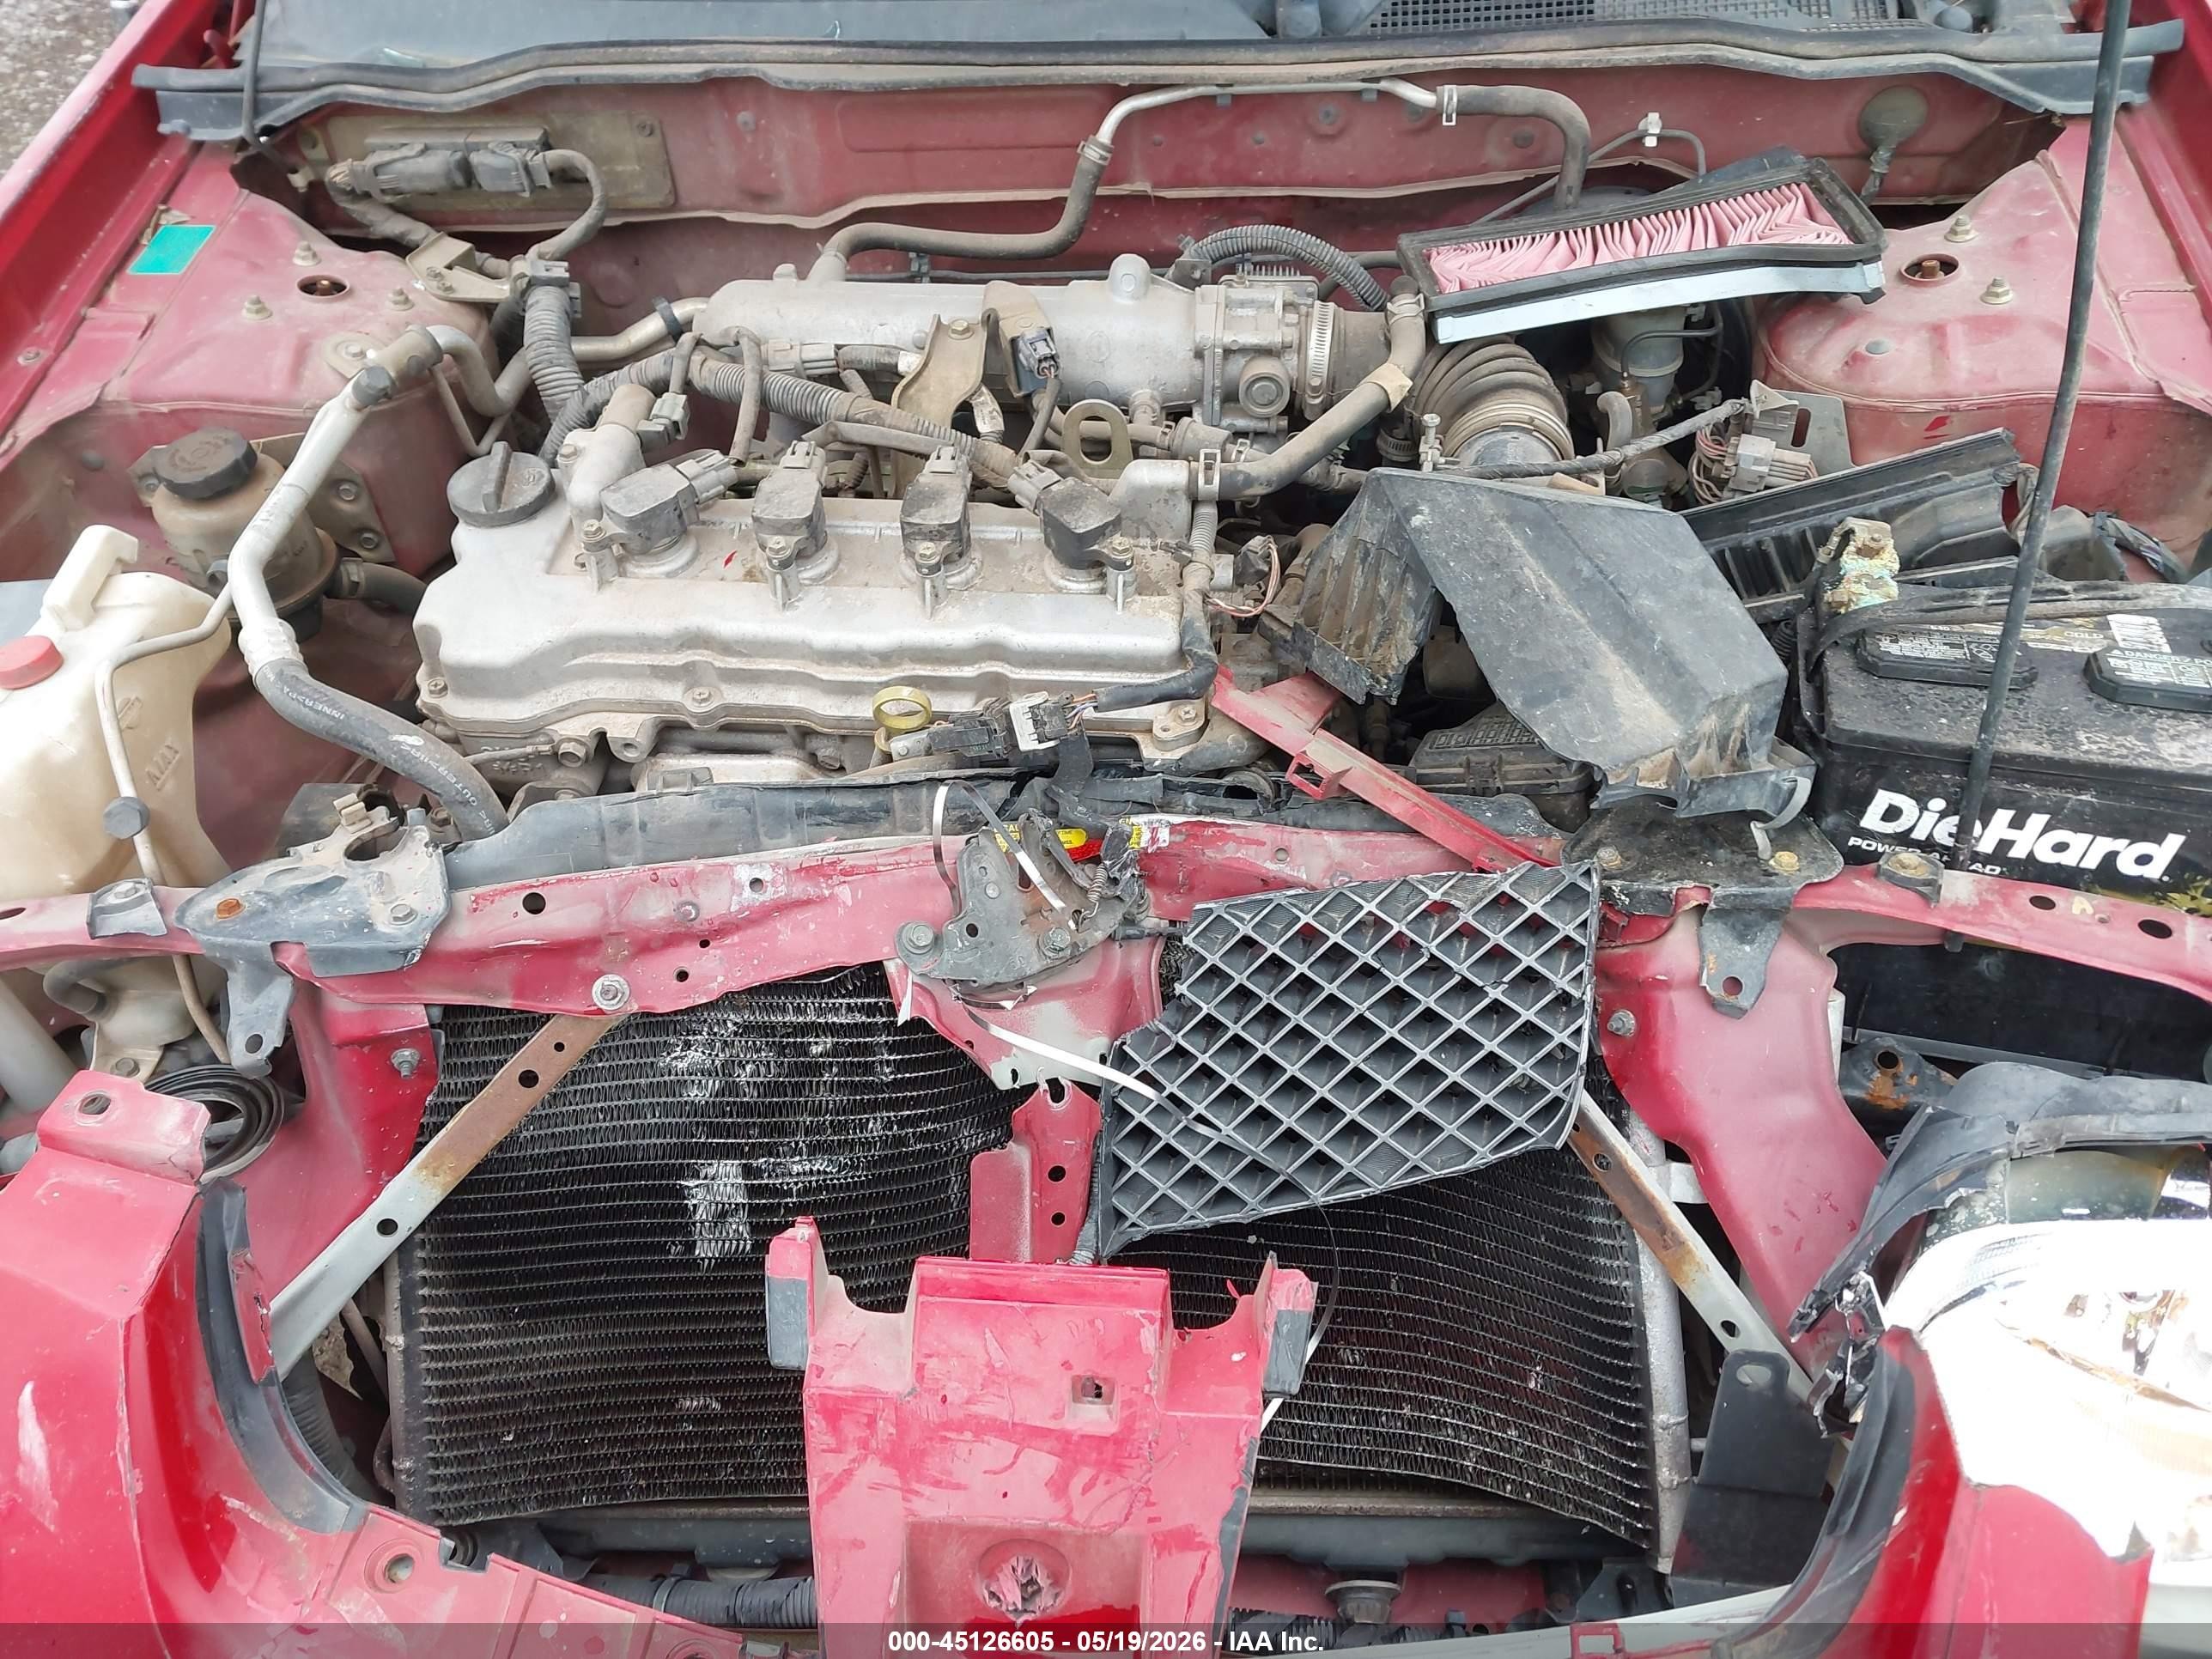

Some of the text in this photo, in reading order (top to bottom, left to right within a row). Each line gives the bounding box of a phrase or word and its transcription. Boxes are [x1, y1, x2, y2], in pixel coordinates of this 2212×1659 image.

[2124, 651, 2182, 662] DANGER
[1859, 788, 2187, 882] DieHard
[1927, 851, 2002, 876] AHAD
